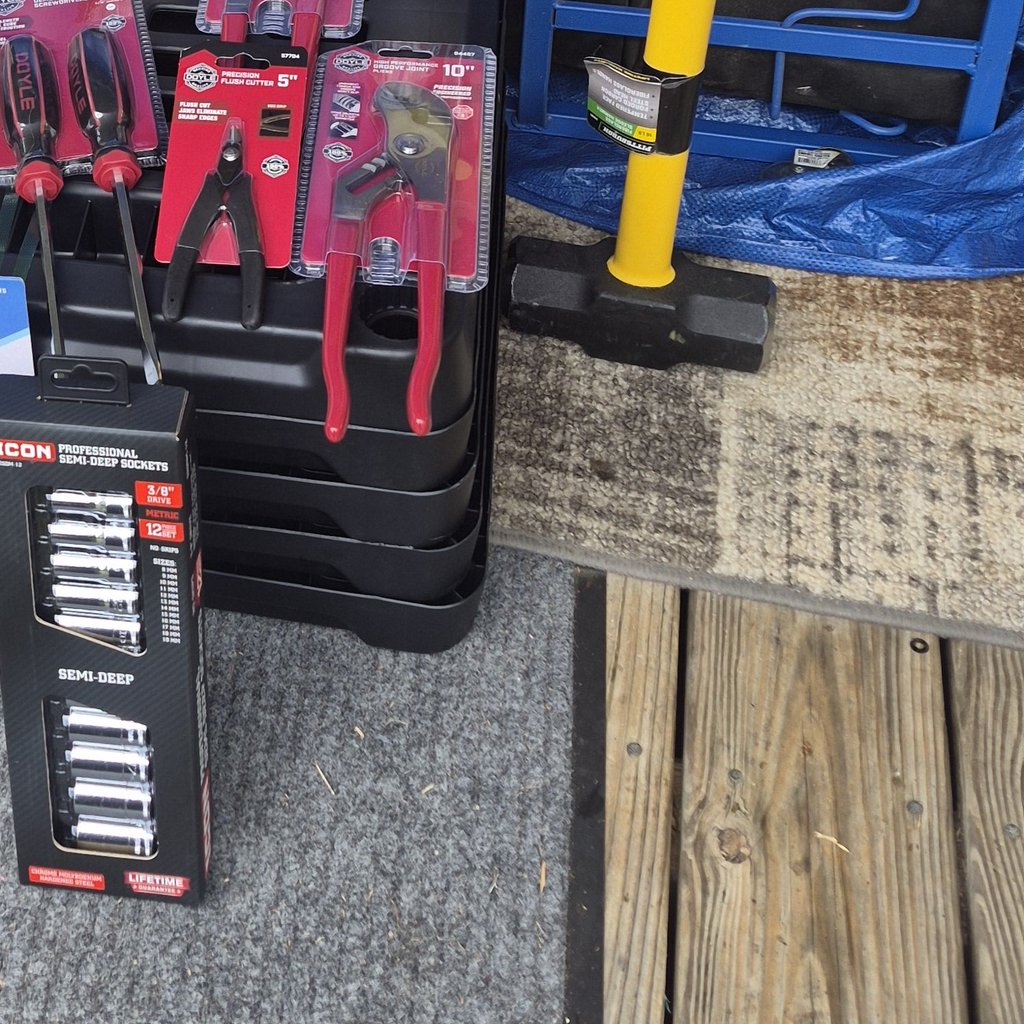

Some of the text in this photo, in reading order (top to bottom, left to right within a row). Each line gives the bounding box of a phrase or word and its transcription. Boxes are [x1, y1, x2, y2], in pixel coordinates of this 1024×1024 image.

[335, 58, 368, 66] DOYLE
[390, 60, 438, 68] PERFORMANCE
[442, 63, 475, 77] 10"
[15, 52, 35, 111] DOYLE
[277, 74, 298, 88] 5"
[58, 443, 138, 459] PROFESSIONAL
[59, 455, 169, 472] SEMI-DEEP SOCKETS
[147, 484, 175, 496] 3/8"
[147, 496, 171, 505] DRIVE
[145, 509, 179, 519] METRIC
[146, 522, 162, 536] 12
[58, 668, 134, 685] SEMI-DEEP
[128, 872, 184, 888] LIFETIME
